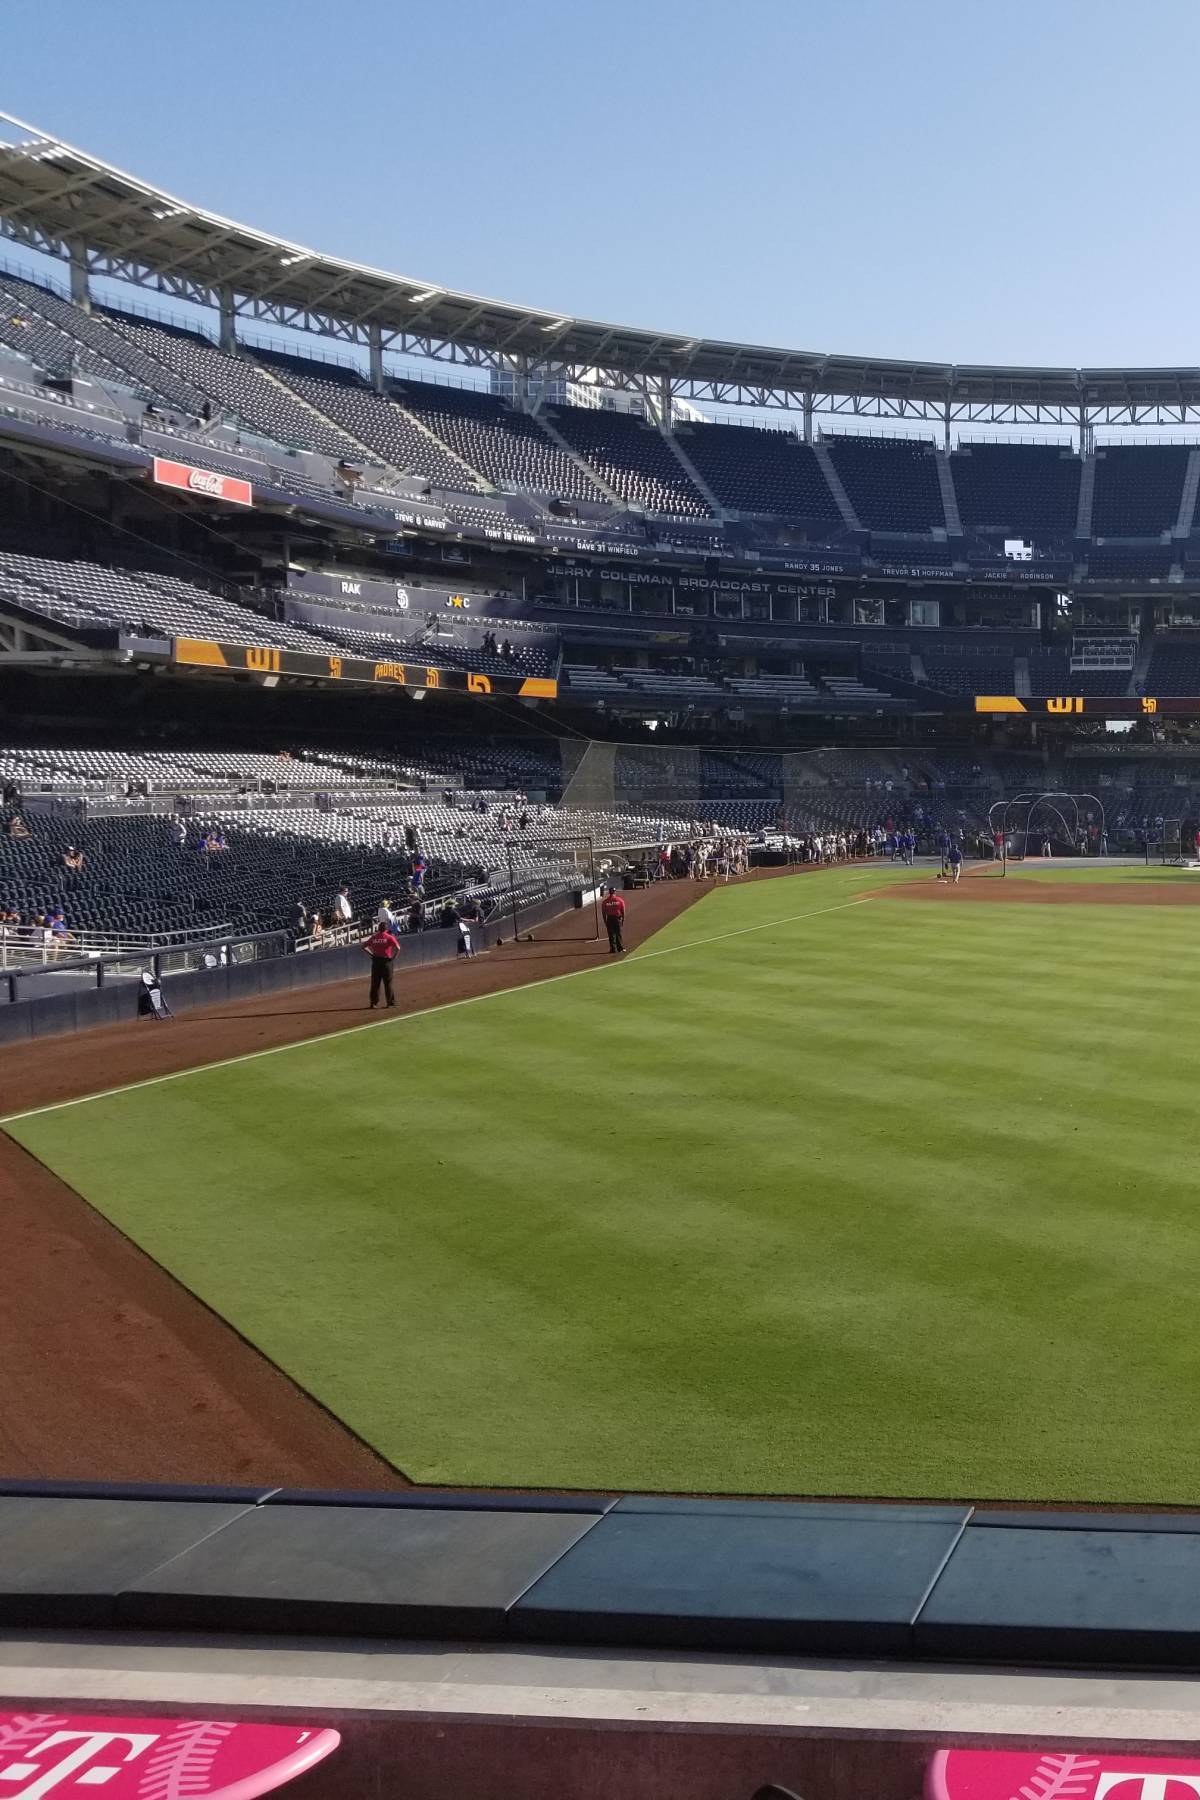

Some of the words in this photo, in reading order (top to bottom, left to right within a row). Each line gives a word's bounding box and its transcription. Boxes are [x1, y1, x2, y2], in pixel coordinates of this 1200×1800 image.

[189, 470, 223, 494] Coca-Cola
[394, 512, 414, 524] STEVE
[424, 518, 446, 529] GARVEY
[484, 529, 501, 539] TONY
[503, 531, 512, 540] 19
[514, 533, 536, 543] GWYNN
[577, 542, 595, 551] DAVE
[597, 544, 606, 552] 31
[608, 546, 638, 556] WINFIELD
[784, 562, 808, 570] RANDY
[882, 568, 909, 576] TREVOR
[911, 569, 920, 577] 51
[546, 564, 594, 578] JERRY
[600, 570, 673, 585] COLEMAN
[679, 577, 770, 592] BROADCAST
[777, 584, 836, 596] CENTER
[341, 581, 361, 595] RAK
[374, 664, 406, 685] PADRES
[295, 1731, 311, 1744] 1
